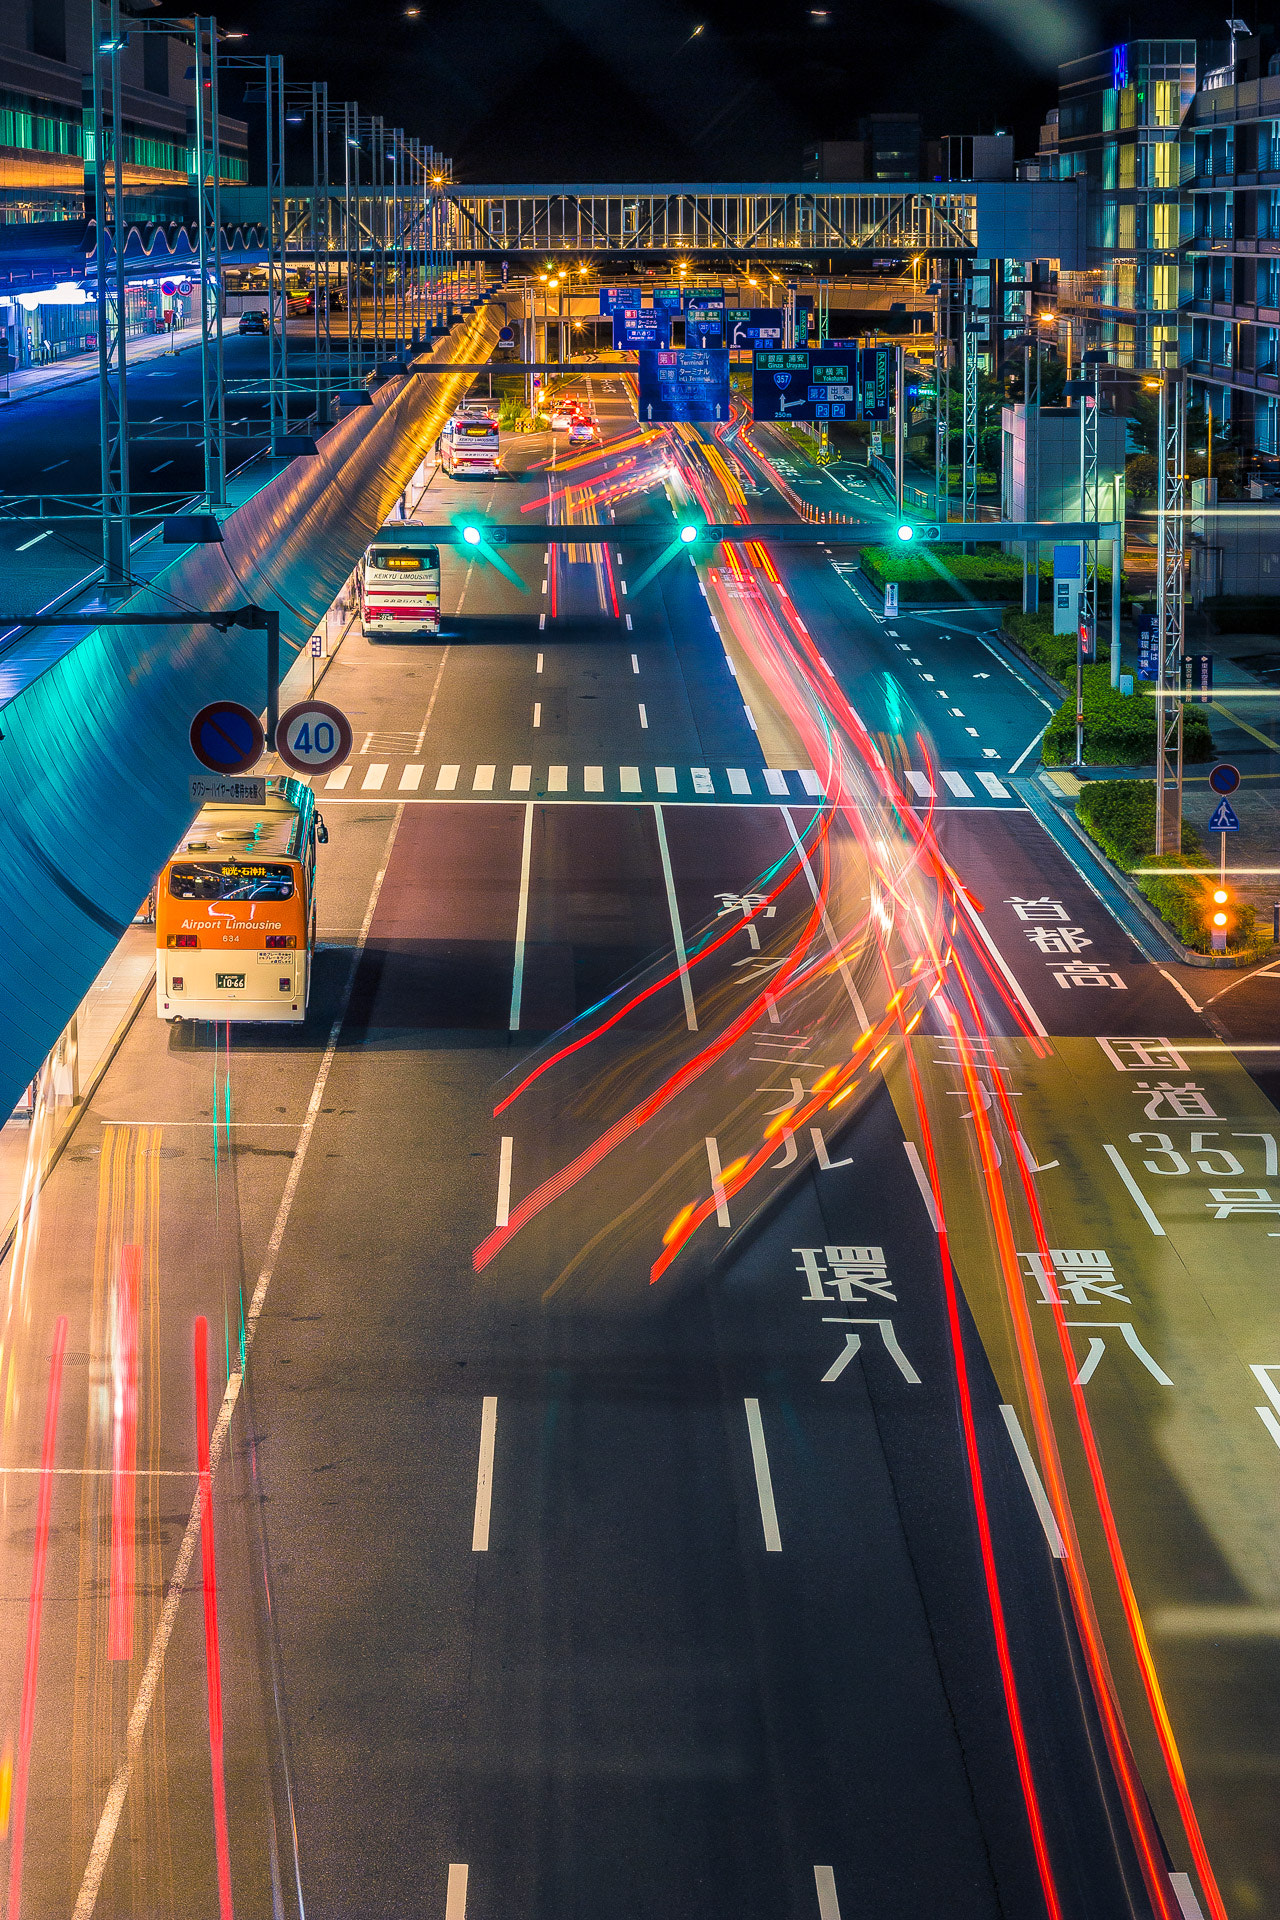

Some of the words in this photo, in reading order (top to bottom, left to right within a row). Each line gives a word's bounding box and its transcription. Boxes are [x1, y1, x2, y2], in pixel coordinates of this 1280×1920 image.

[180, 284, 190, 292] 40
[659, 354, 675, 364] 第1
[678, 352, 710, 360] ターミナル
[768, 354, 784, 363] 銀座
[788, 354, 805, 363] 浦安
[825, 368, 844, 376] 横浜
[776, 375, 789, 383] 357
[810, 388, 826, 399] 第2
[830, 386, 850, 395] 出発
[817, 405, 828, 416] P3
[833, 405, 844, 416] P4
[293, 722, 335, 754] 40
[181, 919, 221, 930] Airport
[225, 919, 282, 930] Limousine
[222, 935, 240, 943] 634
[1003, 896, 1128, 991] 首都高
[792, 1245, 922, 1385] 環八
[1017, 1248, 1174, 1386] 環八
